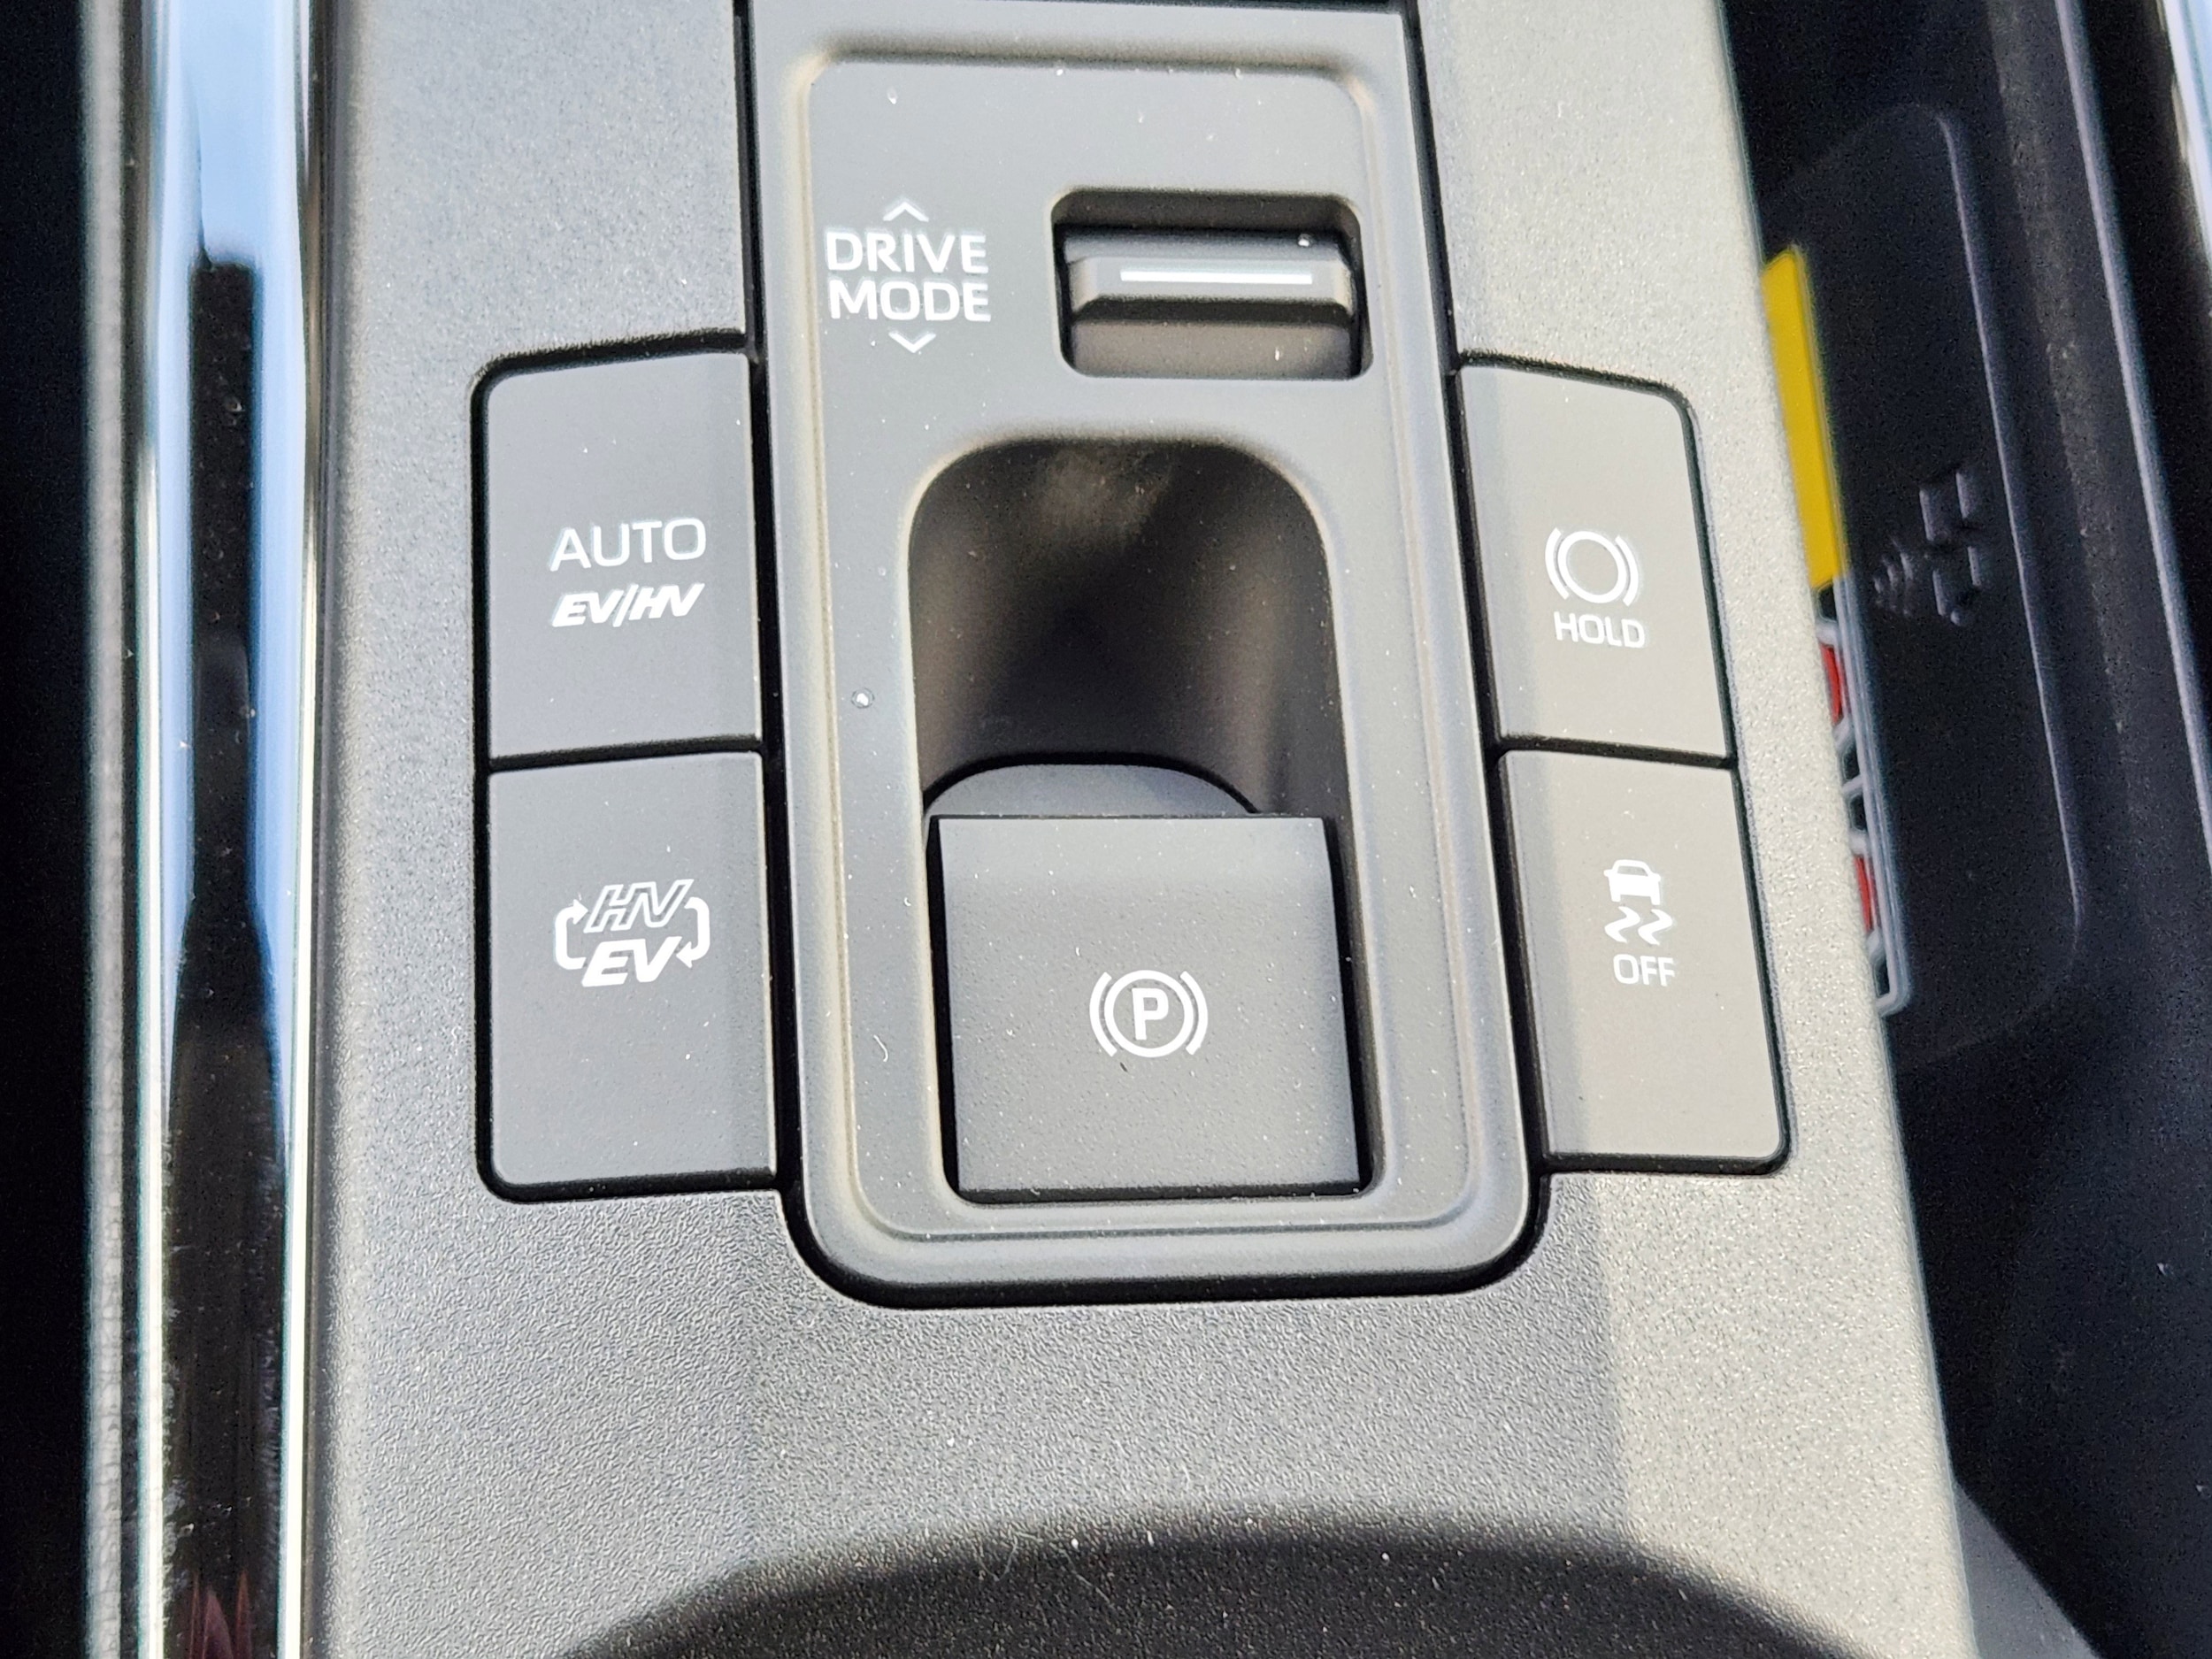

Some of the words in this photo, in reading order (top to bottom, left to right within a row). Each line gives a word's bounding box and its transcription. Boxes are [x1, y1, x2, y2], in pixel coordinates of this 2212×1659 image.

[825, 230, 989, 274] DRIVE
[828, 277, 992, 322] MODE
[549, 516, 707, 572] AUTO
[1553, 611, 1646, 649] HOLD
[581, 935, 683, 987] EV
[1613, 953, 1675, 987] OFF
[1132, 987, 1169, 1041] P
